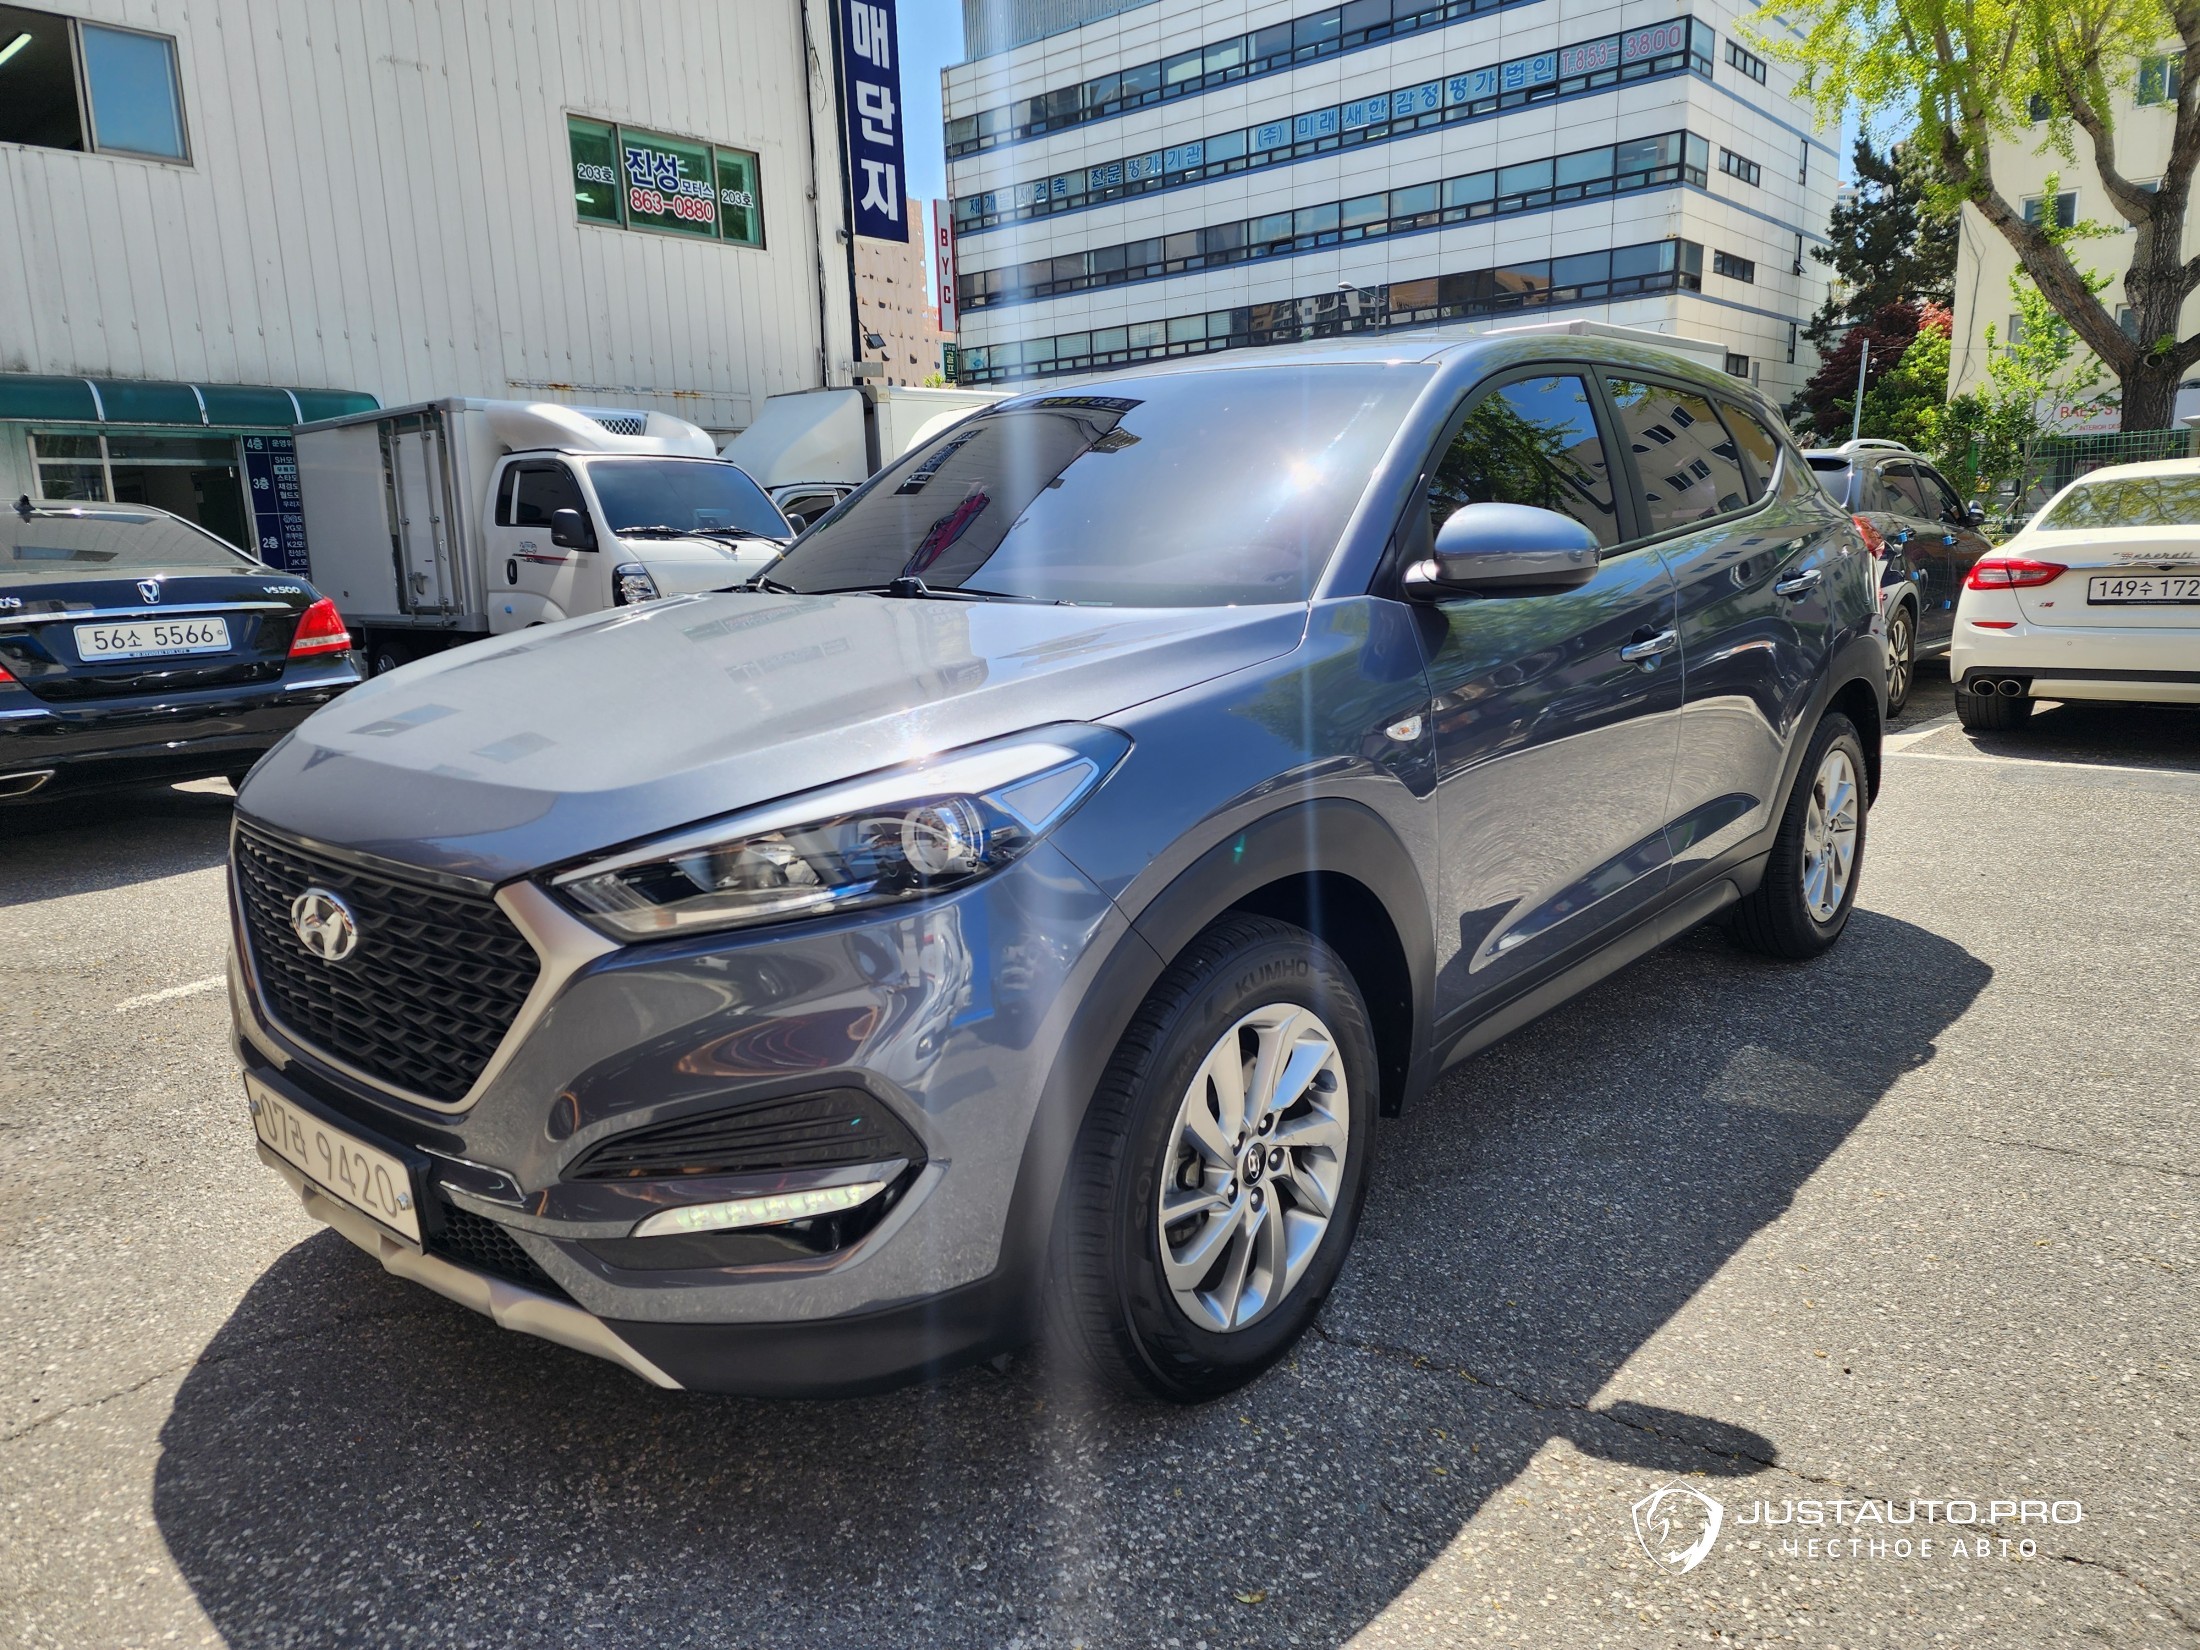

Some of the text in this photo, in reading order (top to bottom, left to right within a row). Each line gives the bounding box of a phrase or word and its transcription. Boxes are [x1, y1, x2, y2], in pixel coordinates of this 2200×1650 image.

[1257, 124, 1283, 147] (주)
[577, 163, 615, 184] 203호
[625, 147, 714, 198] 진성 모터스
[630, 187, 715, 223] 863-0880
[722, 189, 754, 208] 203호
[940, 228, 951, 304] BYC
[247, 437, 263, 450] 4층
[252, 477, 270, 490] 3층
[262, 536, 279, 549] 2층
[262, 585, 302, 594] VS500
[2099, 580, 2200, 597] 149수 172
[94, 624, 215, 650] 56소 5566
[1235, 958, 1309, 997] KUMHO
[260, 1093, 398, 1219] 07라 9420
